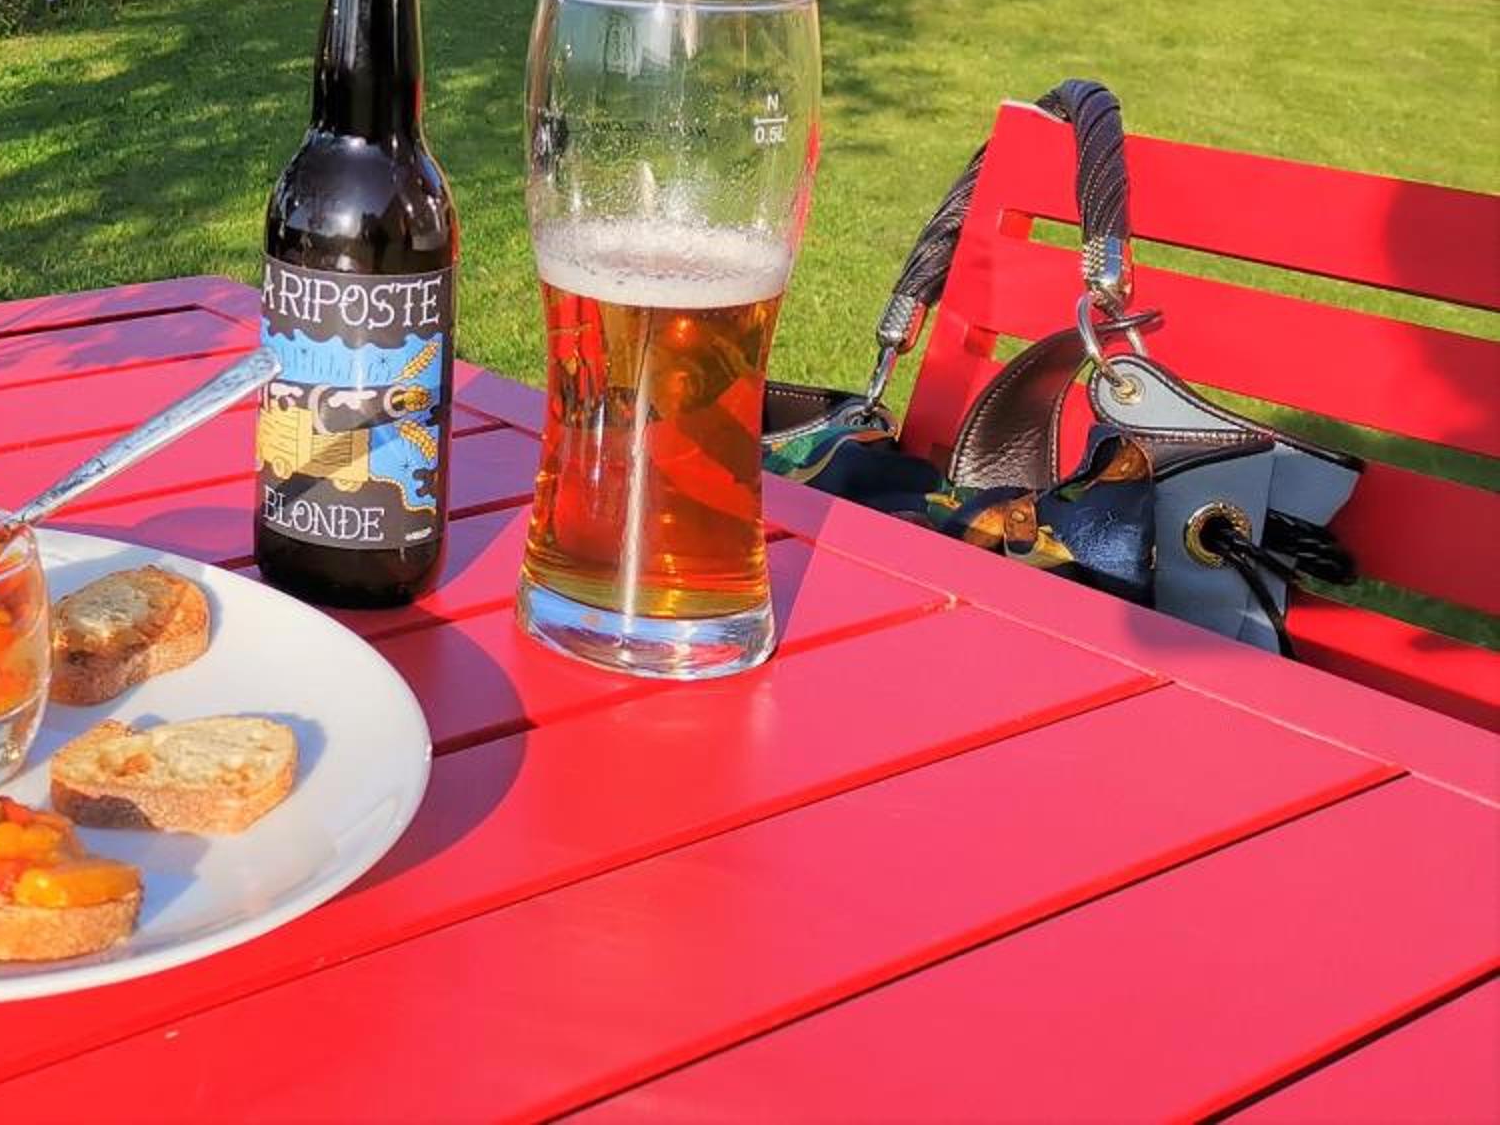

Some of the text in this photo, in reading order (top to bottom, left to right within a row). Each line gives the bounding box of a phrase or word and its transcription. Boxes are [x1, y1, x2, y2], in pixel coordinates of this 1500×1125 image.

[767, 93, 779, 111] N
[279, 269, 442, 329] RIPOSTE
[263, 485, 385, 541] BLONDE
